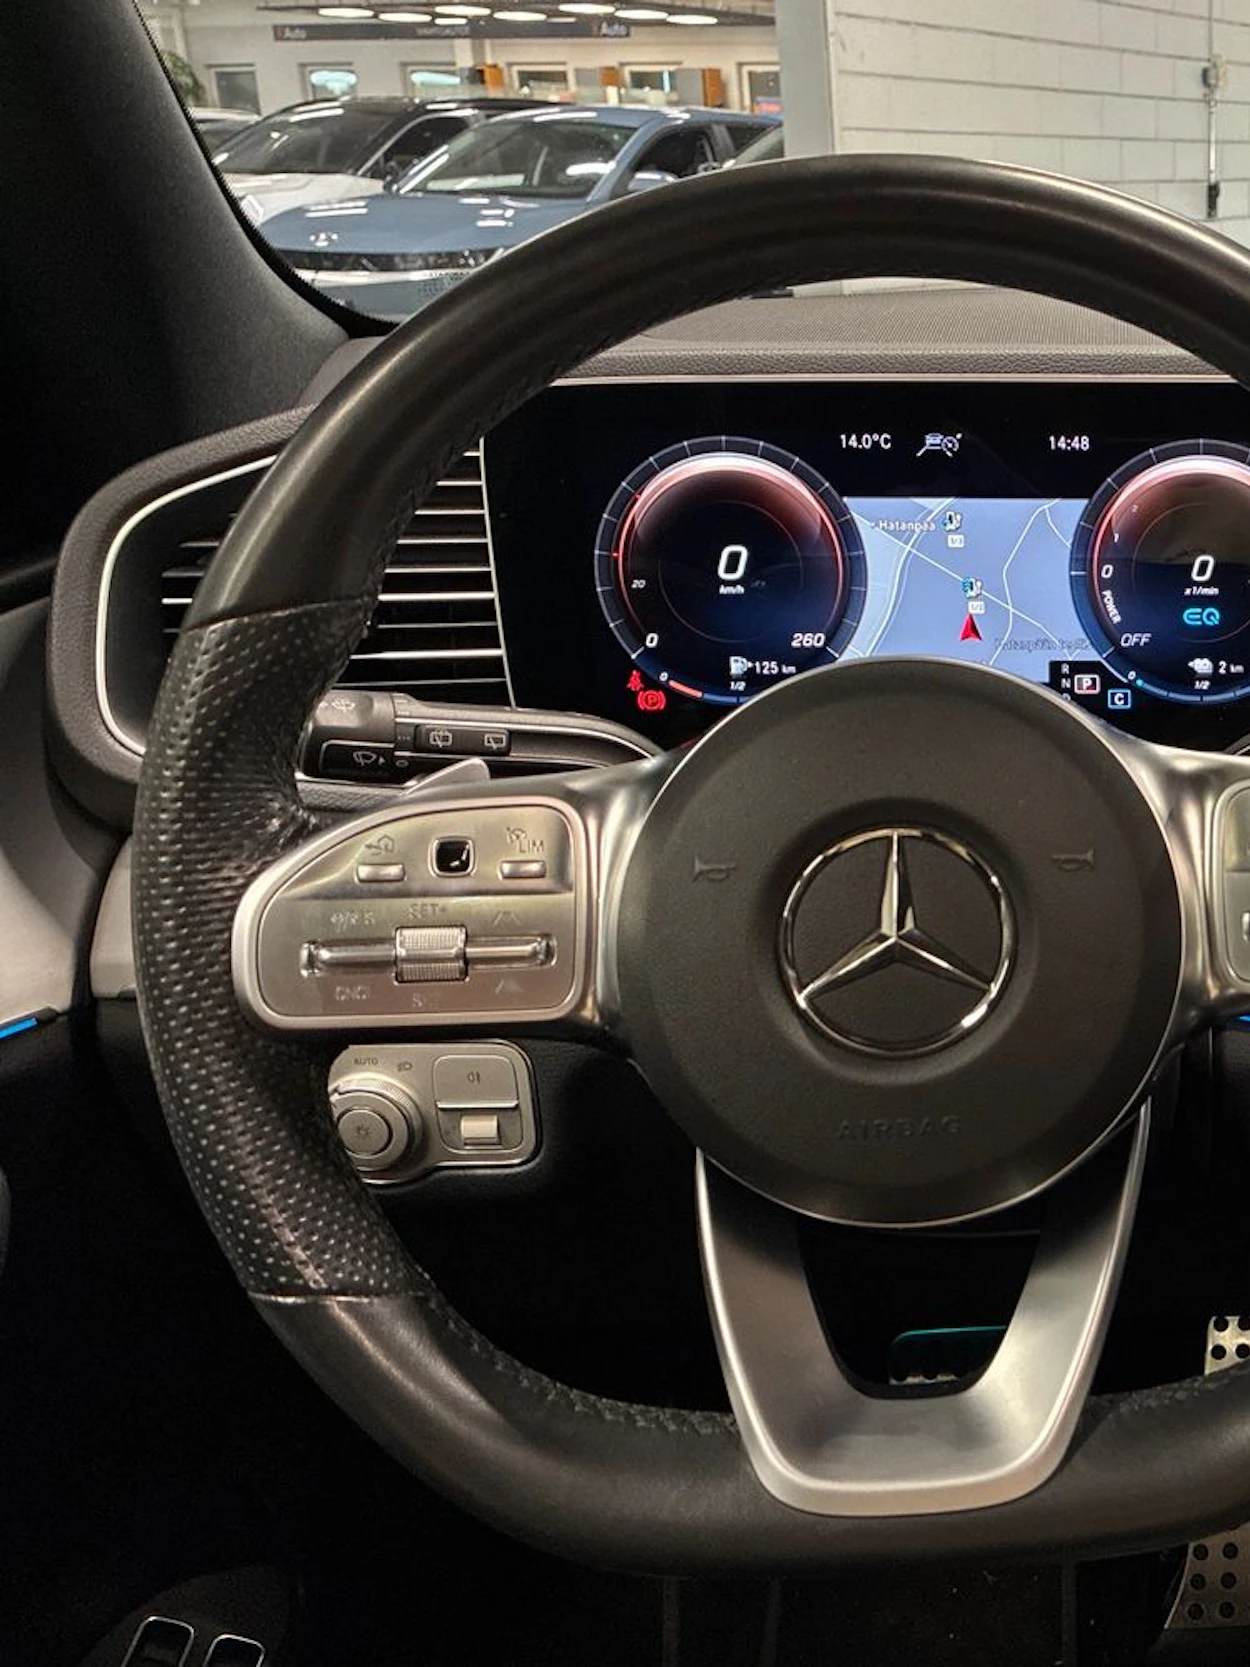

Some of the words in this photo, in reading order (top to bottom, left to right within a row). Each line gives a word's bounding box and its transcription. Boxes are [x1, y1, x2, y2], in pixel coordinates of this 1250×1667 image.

[839, 434, 892, 450] 14.0°C
[1049, 436, 1090, 451] 14:48
[717, 544, 748, 581] 0
[1191, 554, 1214, 582] 0
[1101, 565, 1113, 579] 0
[631, 579, 646, 589] 20
[719, 584, 745, 595] km/h
[1184, 587, 1219, 597] x1/min
[1101, 590, 1122, 625] POWER
[1182, 607, 1221, 627] EQ
[645, 632, 659, 647] 0
[791, 632, 826, 647] 260
[1120, 632, 1152, 647] OFF
[755, 661, 778, 675] 125
[782, 664, 796, 674] km
[1061, 663, 1069, 675] R
[1218, 660, 1226, 674] 2
[1230, 663, 1244, 674] km
[660, 671, 669, 682] 0
[1127, 671, 1136, 681] 0
[729, 681, 746, 691] 1/2
[1061, 678, 1071, 689] N
[1082, 678, 1092, 690] P
[1194, 680, 1210, 690] 1/2
[1114, 693, 1125, 705] C
[518, 839, 545, 854] LIM
[354, 1058, 379, 1066] AUTO
